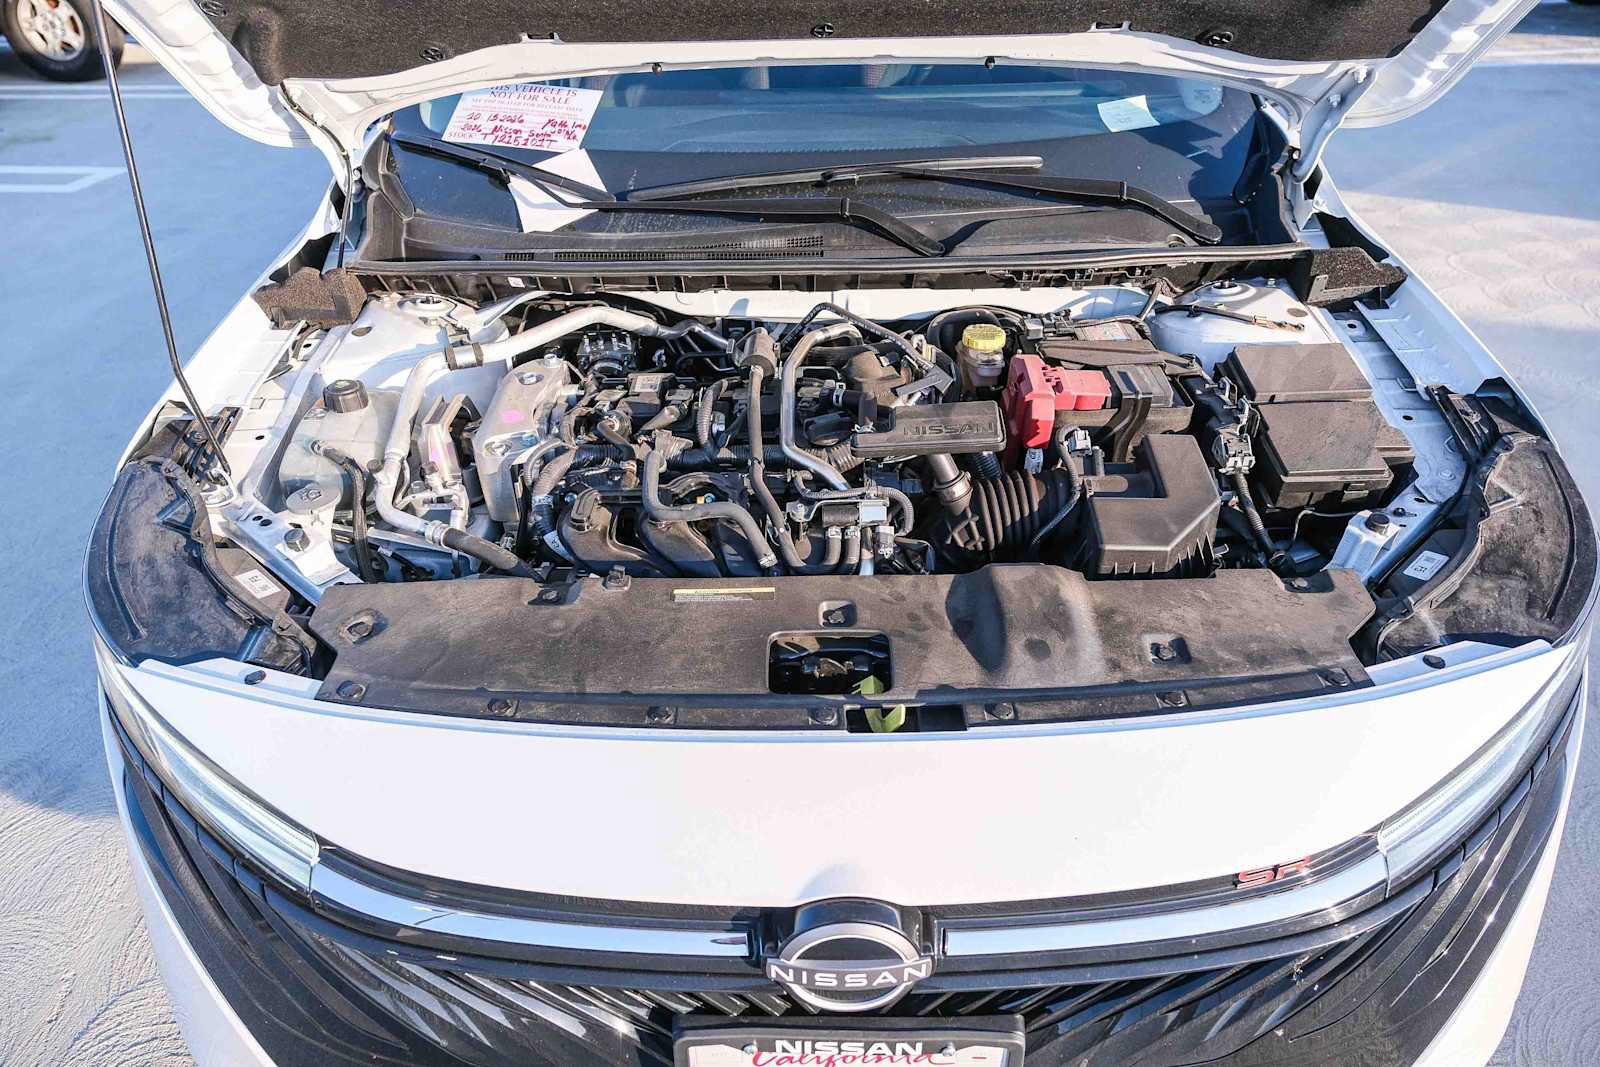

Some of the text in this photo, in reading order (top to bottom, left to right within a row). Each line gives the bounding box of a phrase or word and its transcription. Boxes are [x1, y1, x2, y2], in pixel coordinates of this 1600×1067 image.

[489, 90, 571, 105] NOT FOR SALE
[512, 84, 562, 96] VEHICLE
[565, 89, 578, 97] IS
[903, 422, 995, 436] NISSAN
[1237, 855, 1311, 889] SR
[770, 962, 929, 987] NISSAN
[775, 1040, 923, 1056] NISSAN
